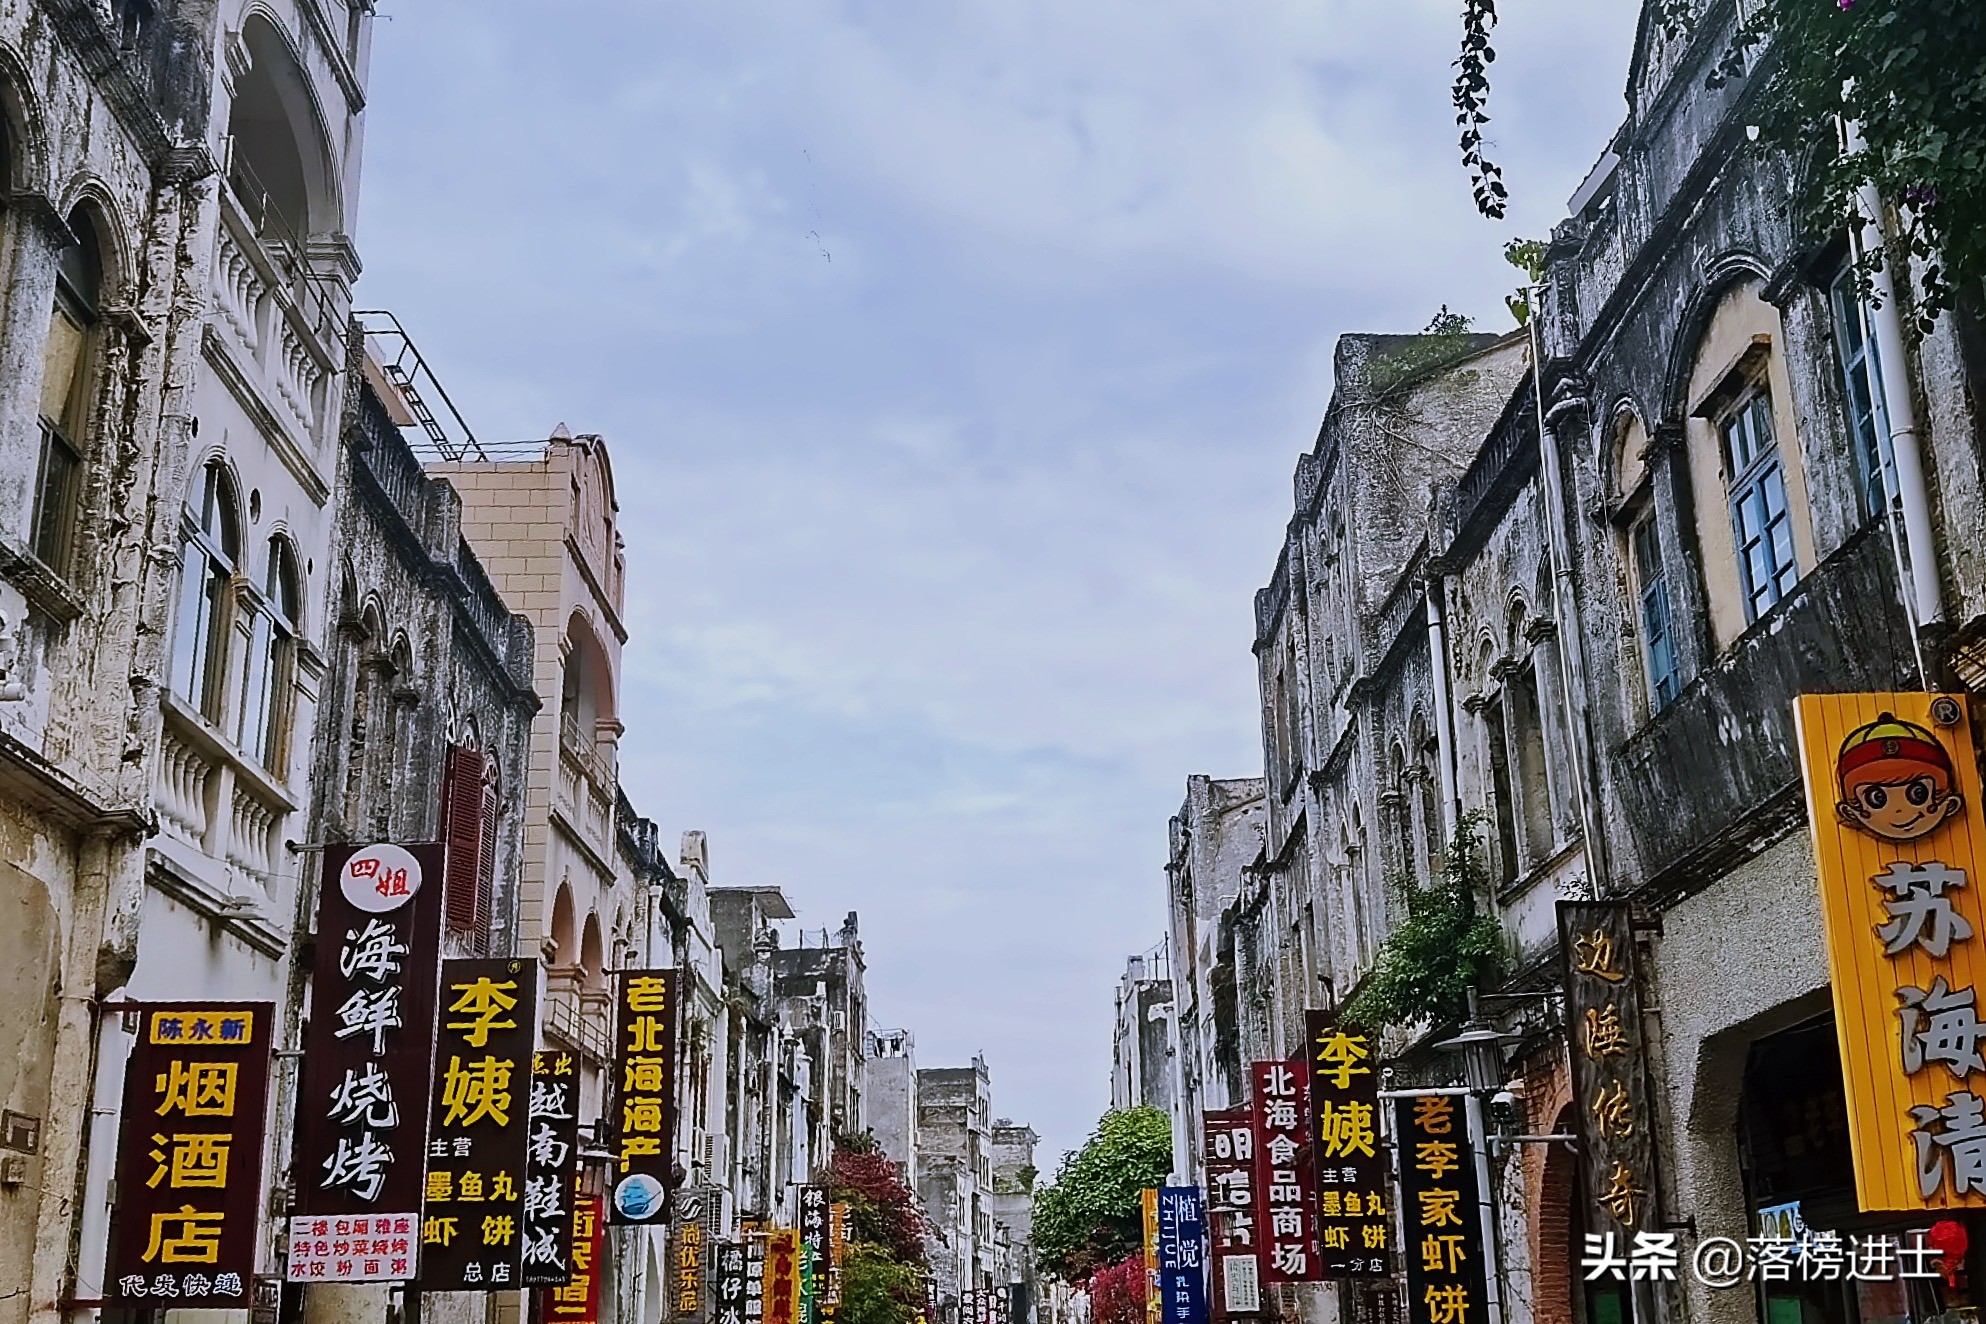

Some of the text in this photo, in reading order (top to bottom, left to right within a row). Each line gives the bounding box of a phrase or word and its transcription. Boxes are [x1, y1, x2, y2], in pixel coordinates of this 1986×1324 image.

[350, 858, 411, 897] 四姐
[157, 1017, 246, 1041] 陈永新
[322, 918, 409, 1203] 海鲜烧烤
[442, 976, 519, 1127] 李姨
[1873, 862, 1986, 1199] 苏海清
[619, 976, 666, 1173] 老北海海产
[1315, 1030, 1375, 1158] 李姨
[1573, 929, 1648, 1233] 边陲传奇
[140, 1059, 239, 1264] 烟酒店
[430, 1137, 473, 1157] 主营
[523, 1082, 573, 1272] 越南鞋城
[1262, 1065, 1307, 1275] 北海食品商场
[1322, 1167, 1358, 1184] 主营
[427, 1171, 519, 1202] 墨鱼丸
[1322, 1190, 1386, 1217] 墨鱼丸
[1414, 1096, 1471, 1324] 老李家虾饼
[1162, 1195, 1177, 1268] ZHIJUE
[1179, 1194, 1199, 1269] 植觉
[1331, 1257, 1383, 1273] 一分店
[119, 1274, 244, 1299] 代发快递
[463, 1262, 512, 1283] 总店
